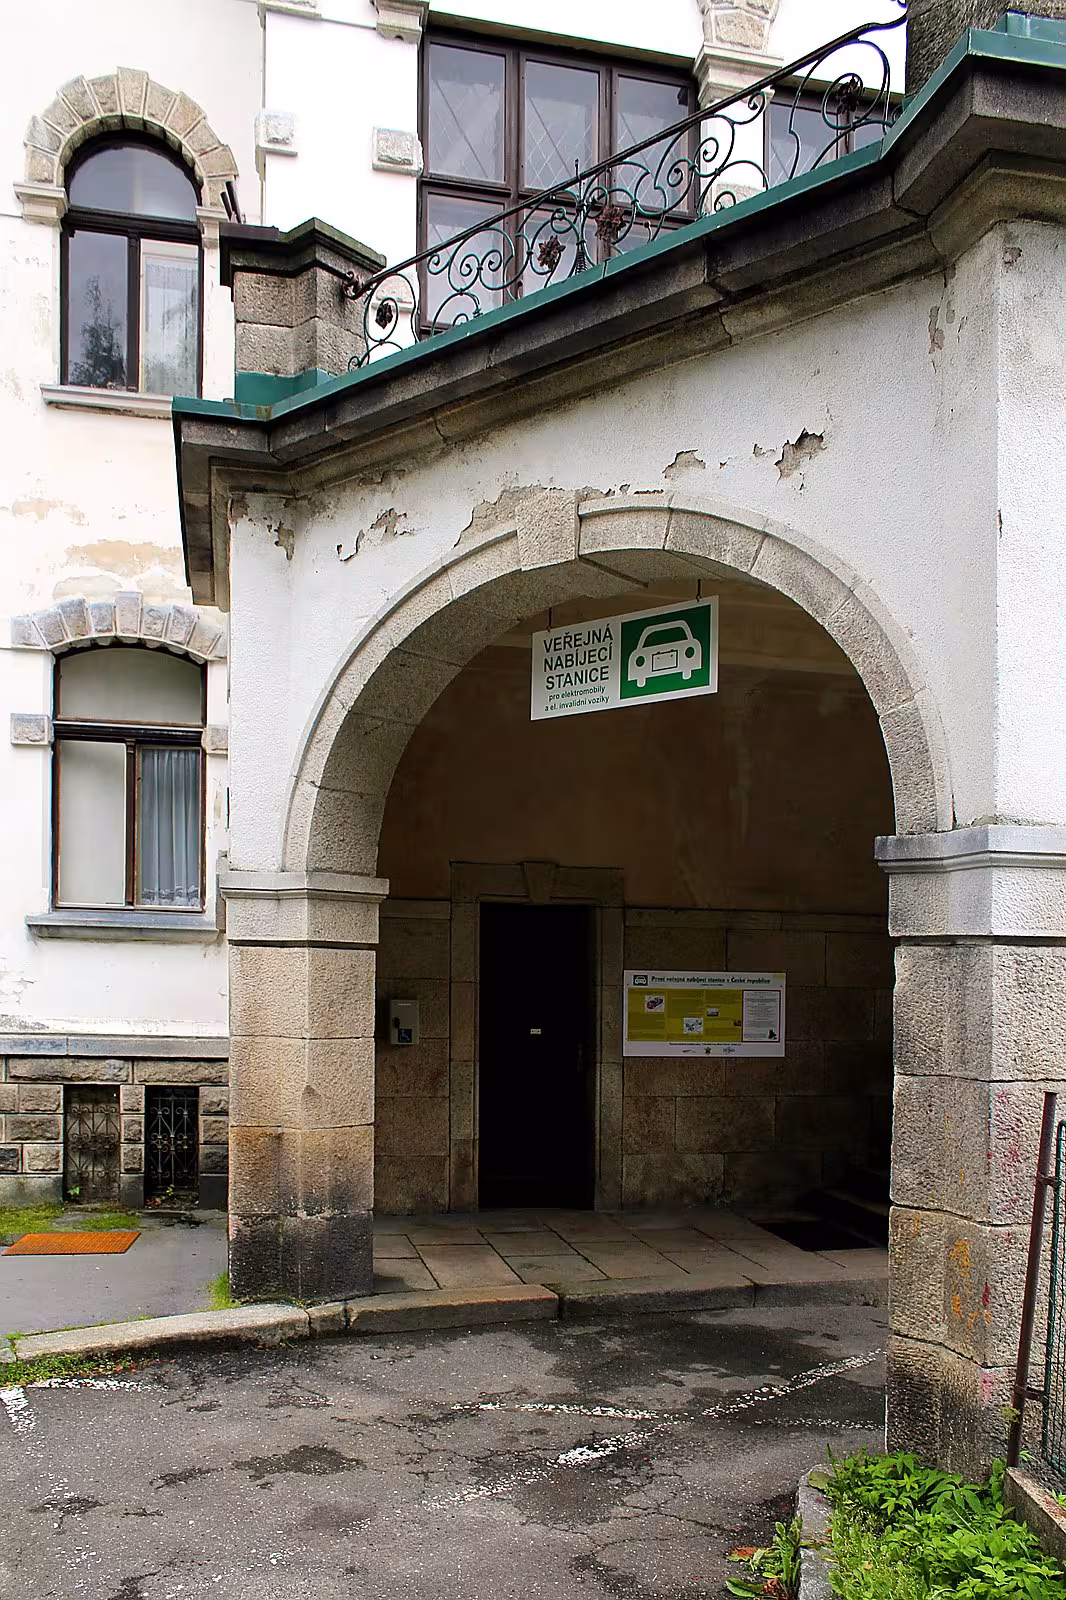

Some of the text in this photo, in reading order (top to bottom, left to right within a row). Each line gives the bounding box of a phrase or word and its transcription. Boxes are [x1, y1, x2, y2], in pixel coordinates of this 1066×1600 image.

[544, 623, 613, 653] VEŘEJNÁ
[544, 642, 613, 673] NABÍJECÍ
[546, 666, 609, 690] STANICE
[548, 685, 606, 702] pro elektromobily
